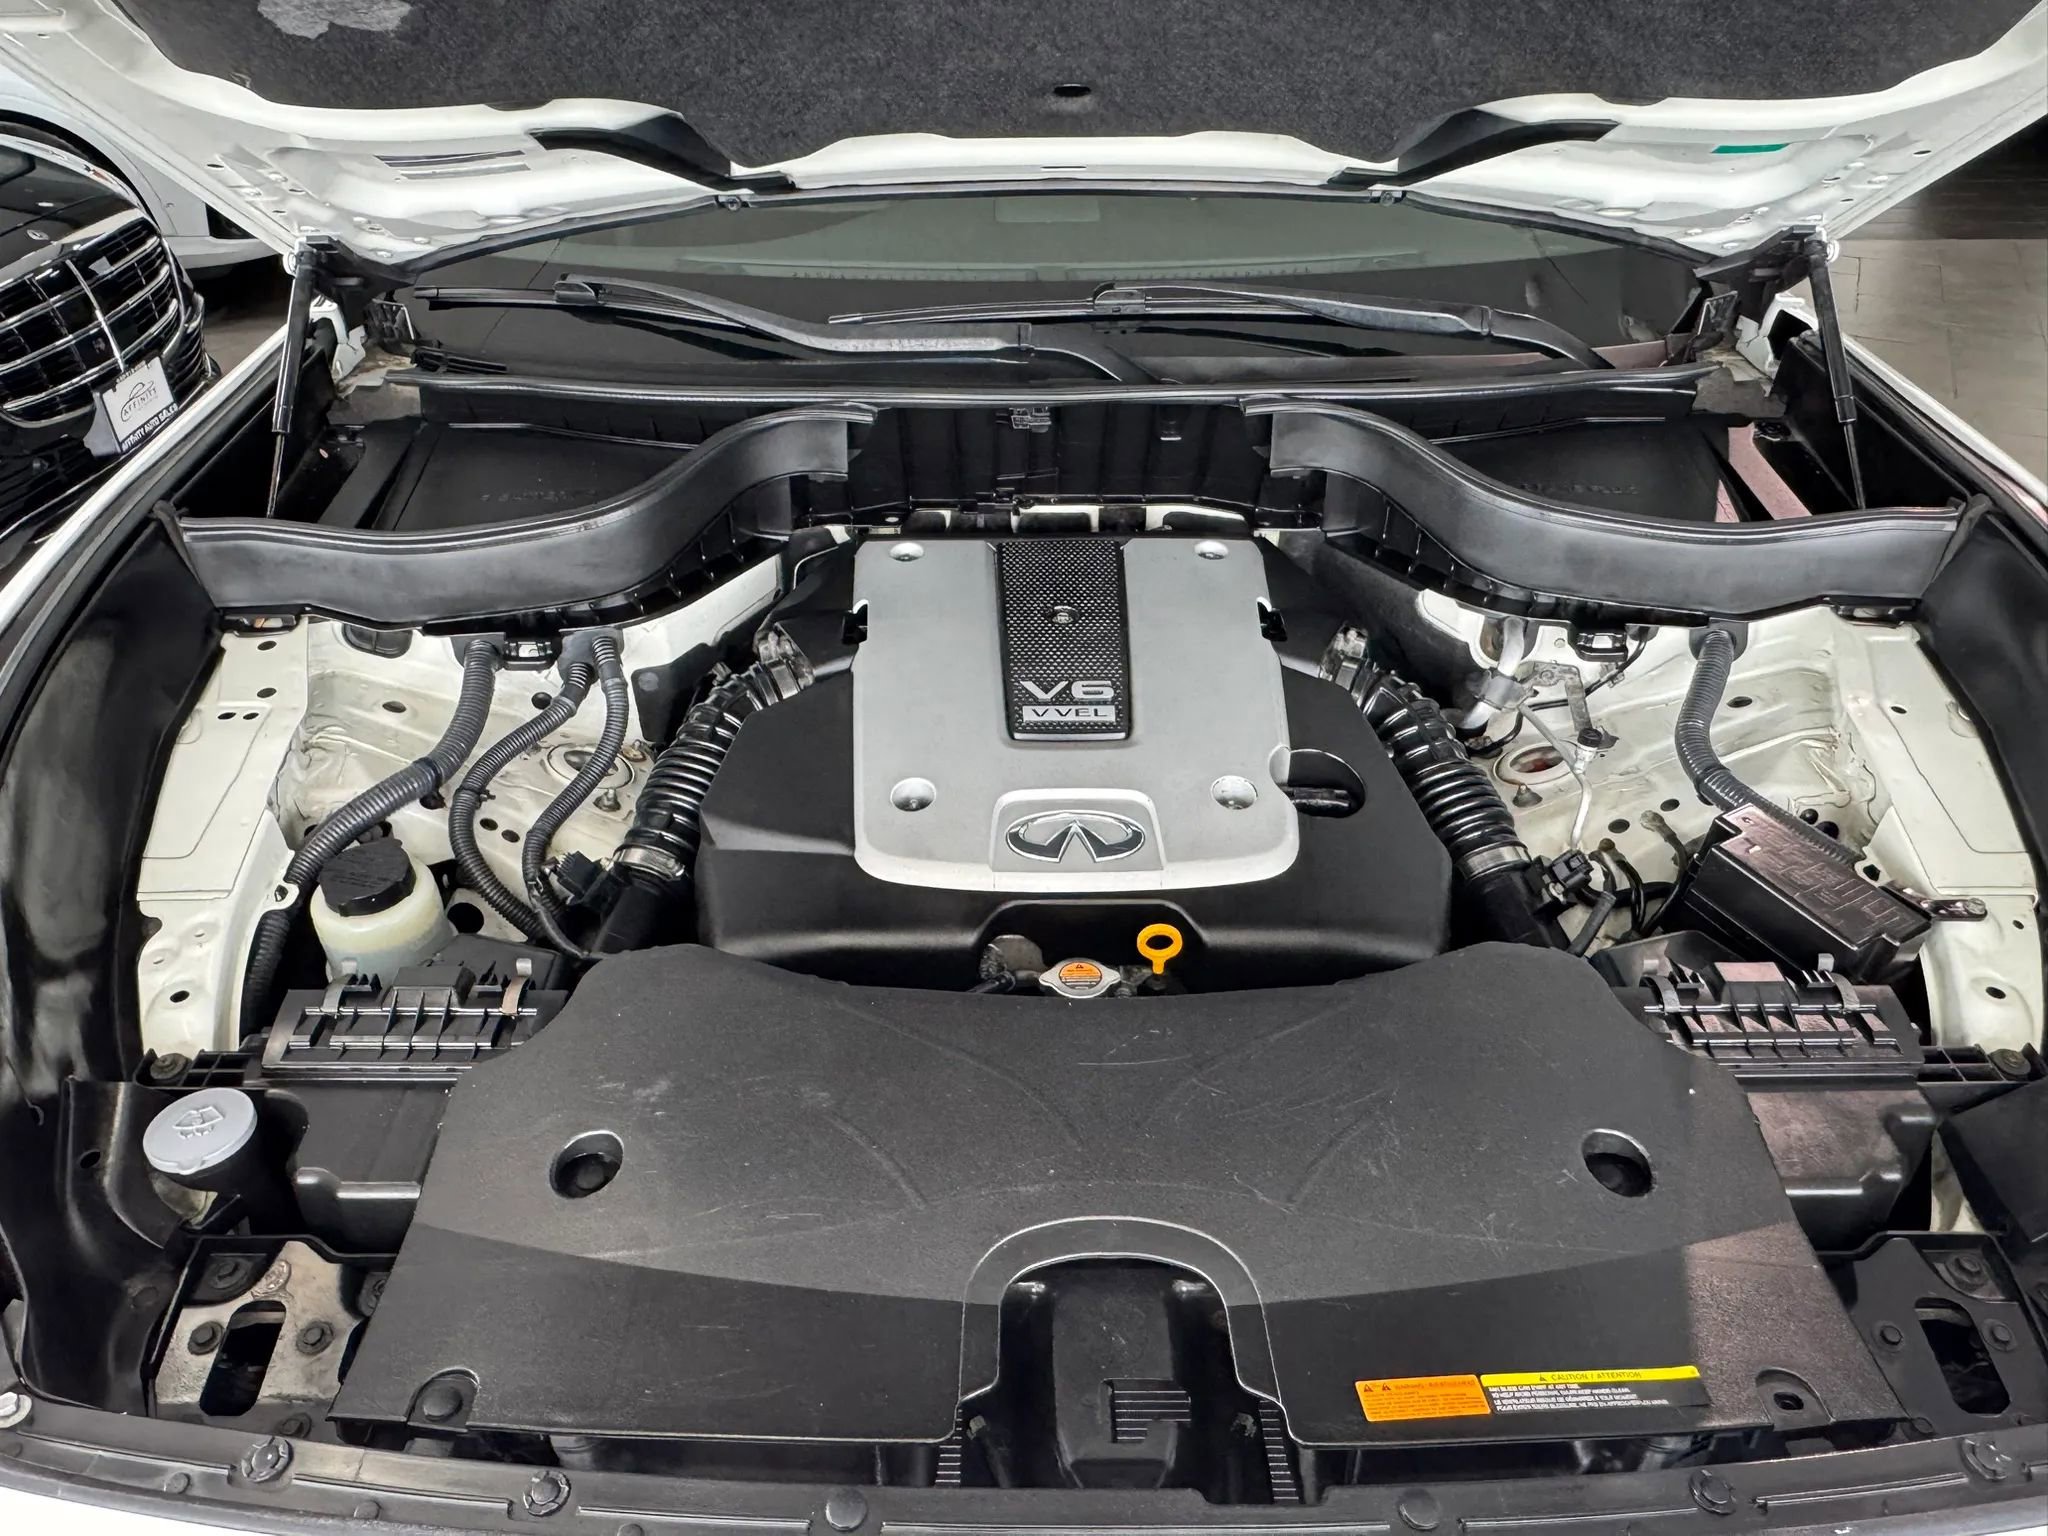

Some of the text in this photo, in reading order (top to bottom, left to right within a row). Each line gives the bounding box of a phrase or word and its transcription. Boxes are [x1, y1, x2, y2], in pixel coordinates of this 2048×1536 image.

[123, 387, 157, 416] AFFINITY
[144, 416, 160, 433] AUTO
[1020, 680, 1115, 702] V6
[1031, 708, 1108, 717] VVEL
[1551, 1373, 1588, 1381] CAUTION
[1597, 1371, 1642, 1380] ATTENTION
